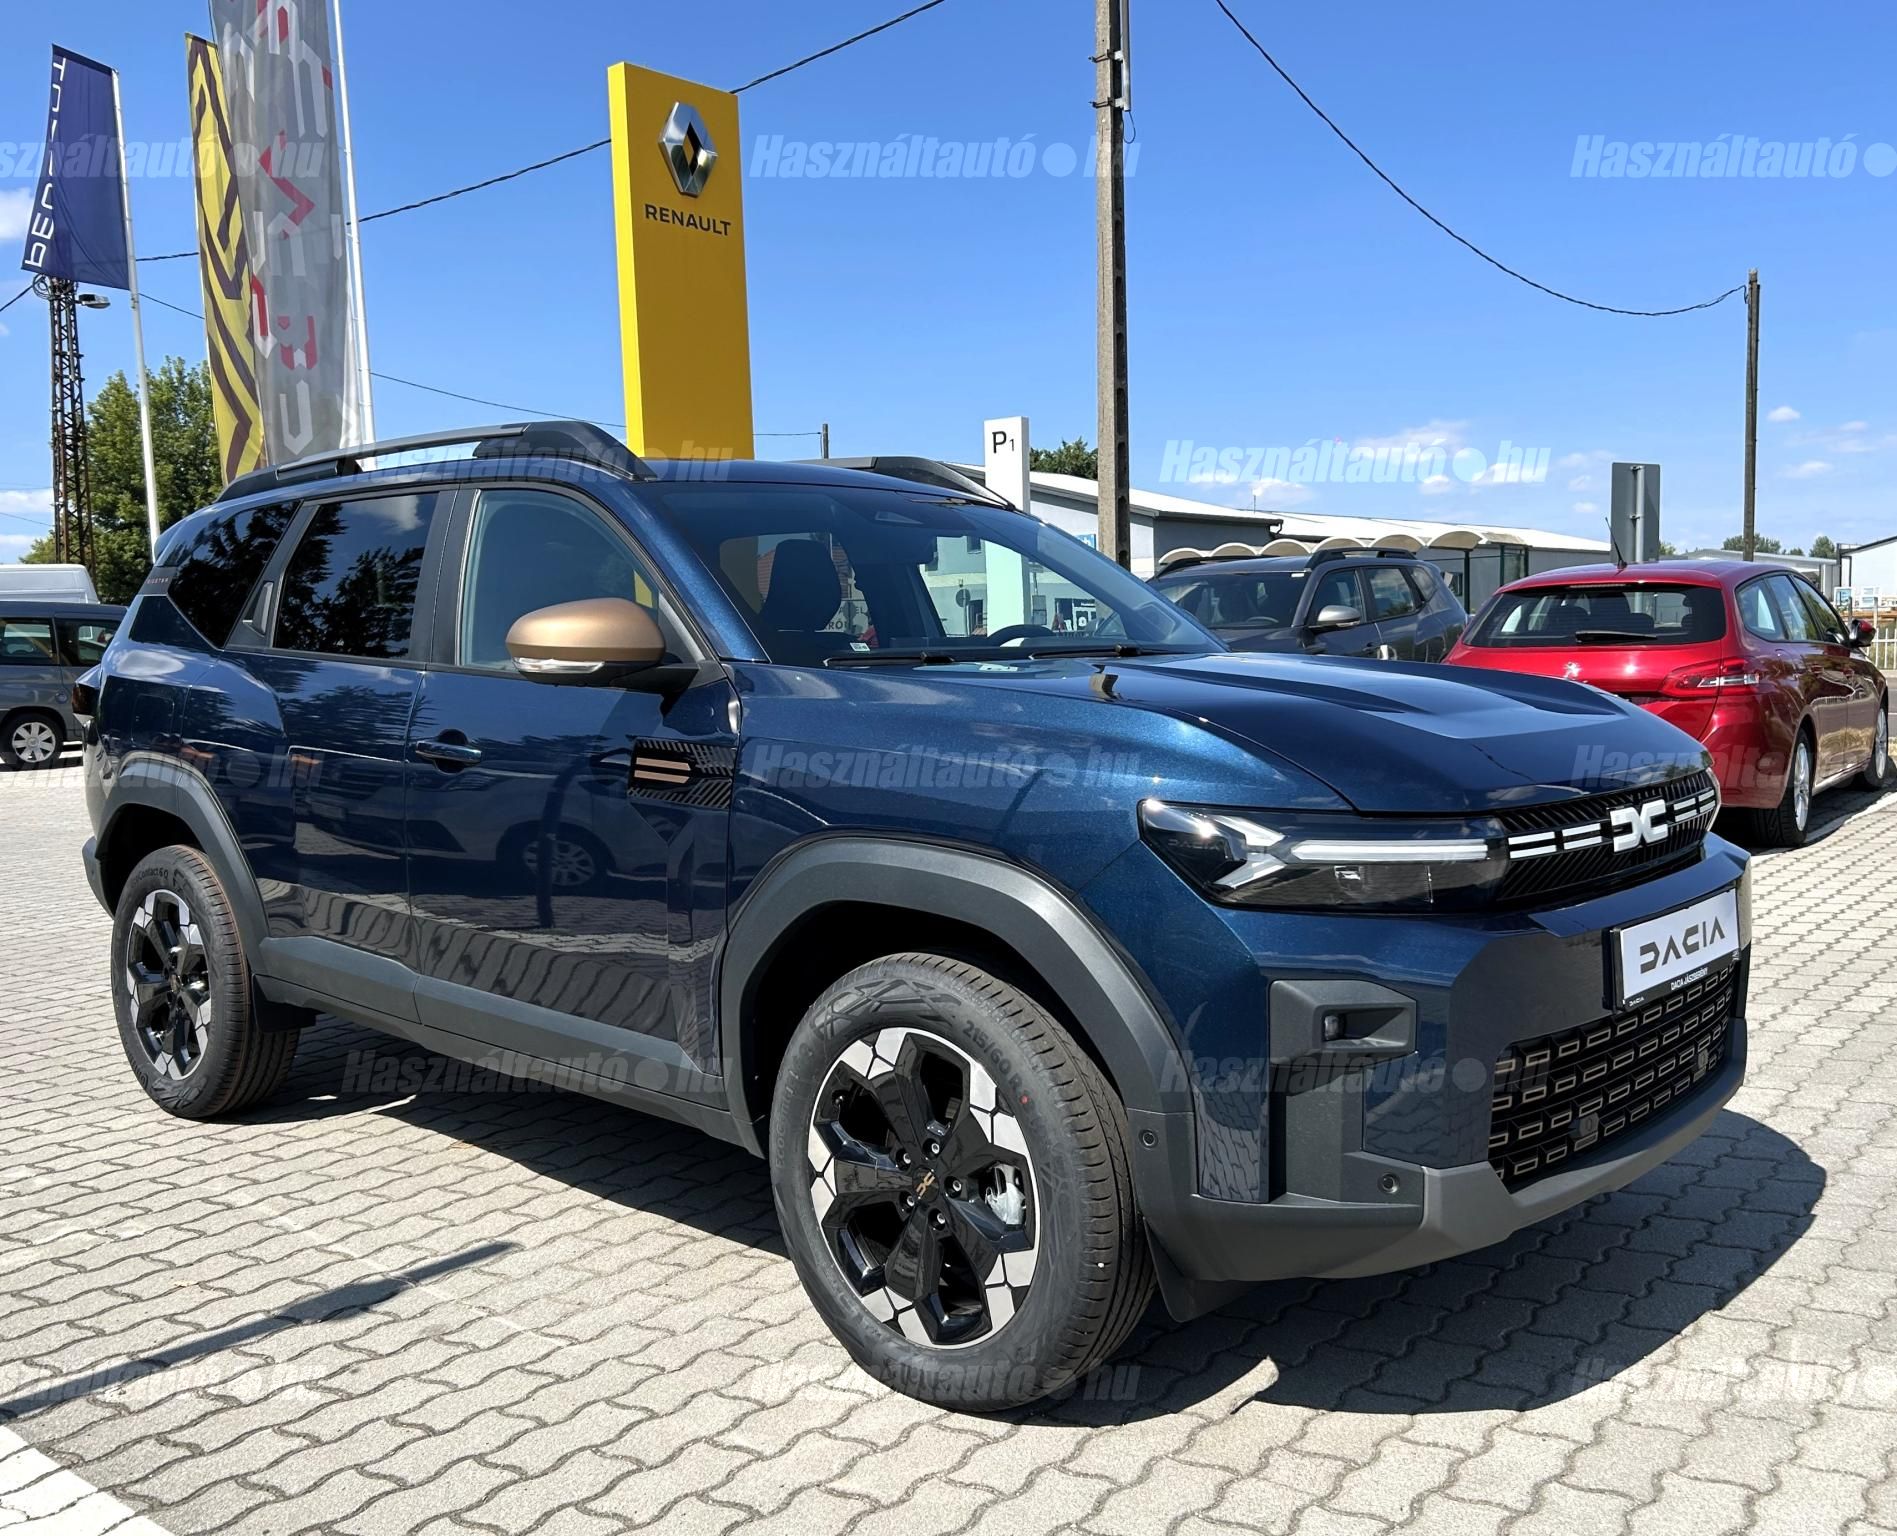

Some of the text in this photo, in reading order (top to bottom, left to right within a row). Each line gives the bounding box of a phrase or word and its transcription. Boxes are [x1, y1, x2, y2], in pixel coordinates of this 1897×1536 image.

[645, 203, 731, 236] RENAULT
[1639, 915, 1726, 974] DACIA
[962, 1019, 1012, 1075] 215/60
